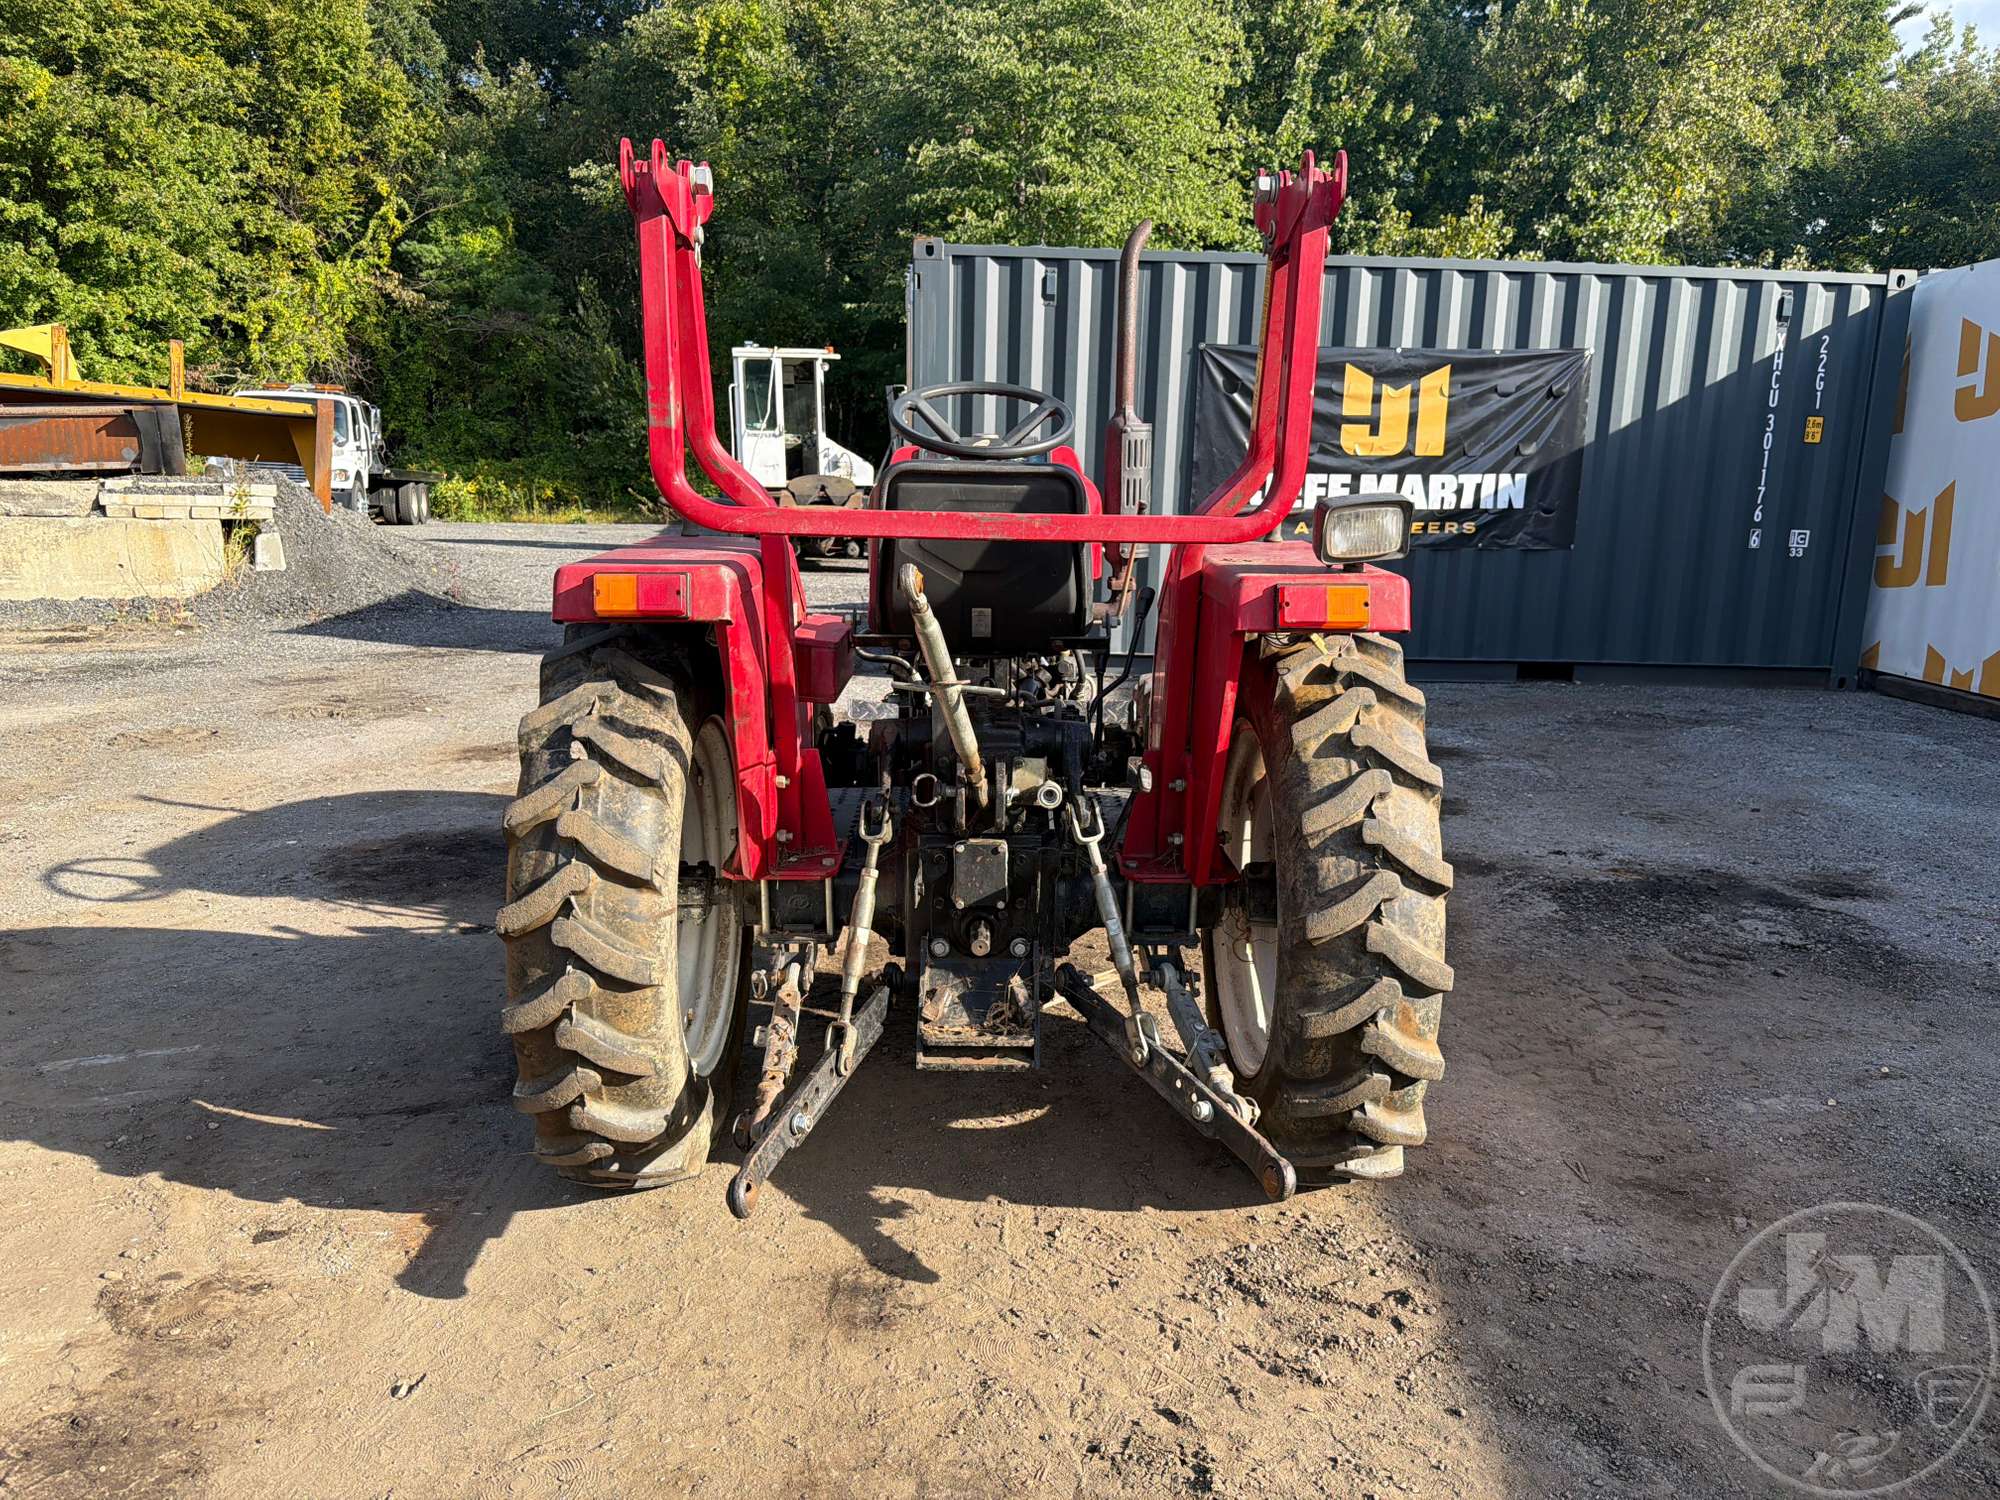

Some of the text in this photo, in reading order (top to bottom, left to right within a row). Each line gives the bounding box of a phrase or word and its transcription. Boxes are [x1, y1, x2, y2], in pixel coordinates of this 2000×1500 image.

[1816, 335, 1830, 410] 22G1
[1750, 332, 1786, 548] XHCU 301176 6
[1789, 548, 1803, 557] 33
